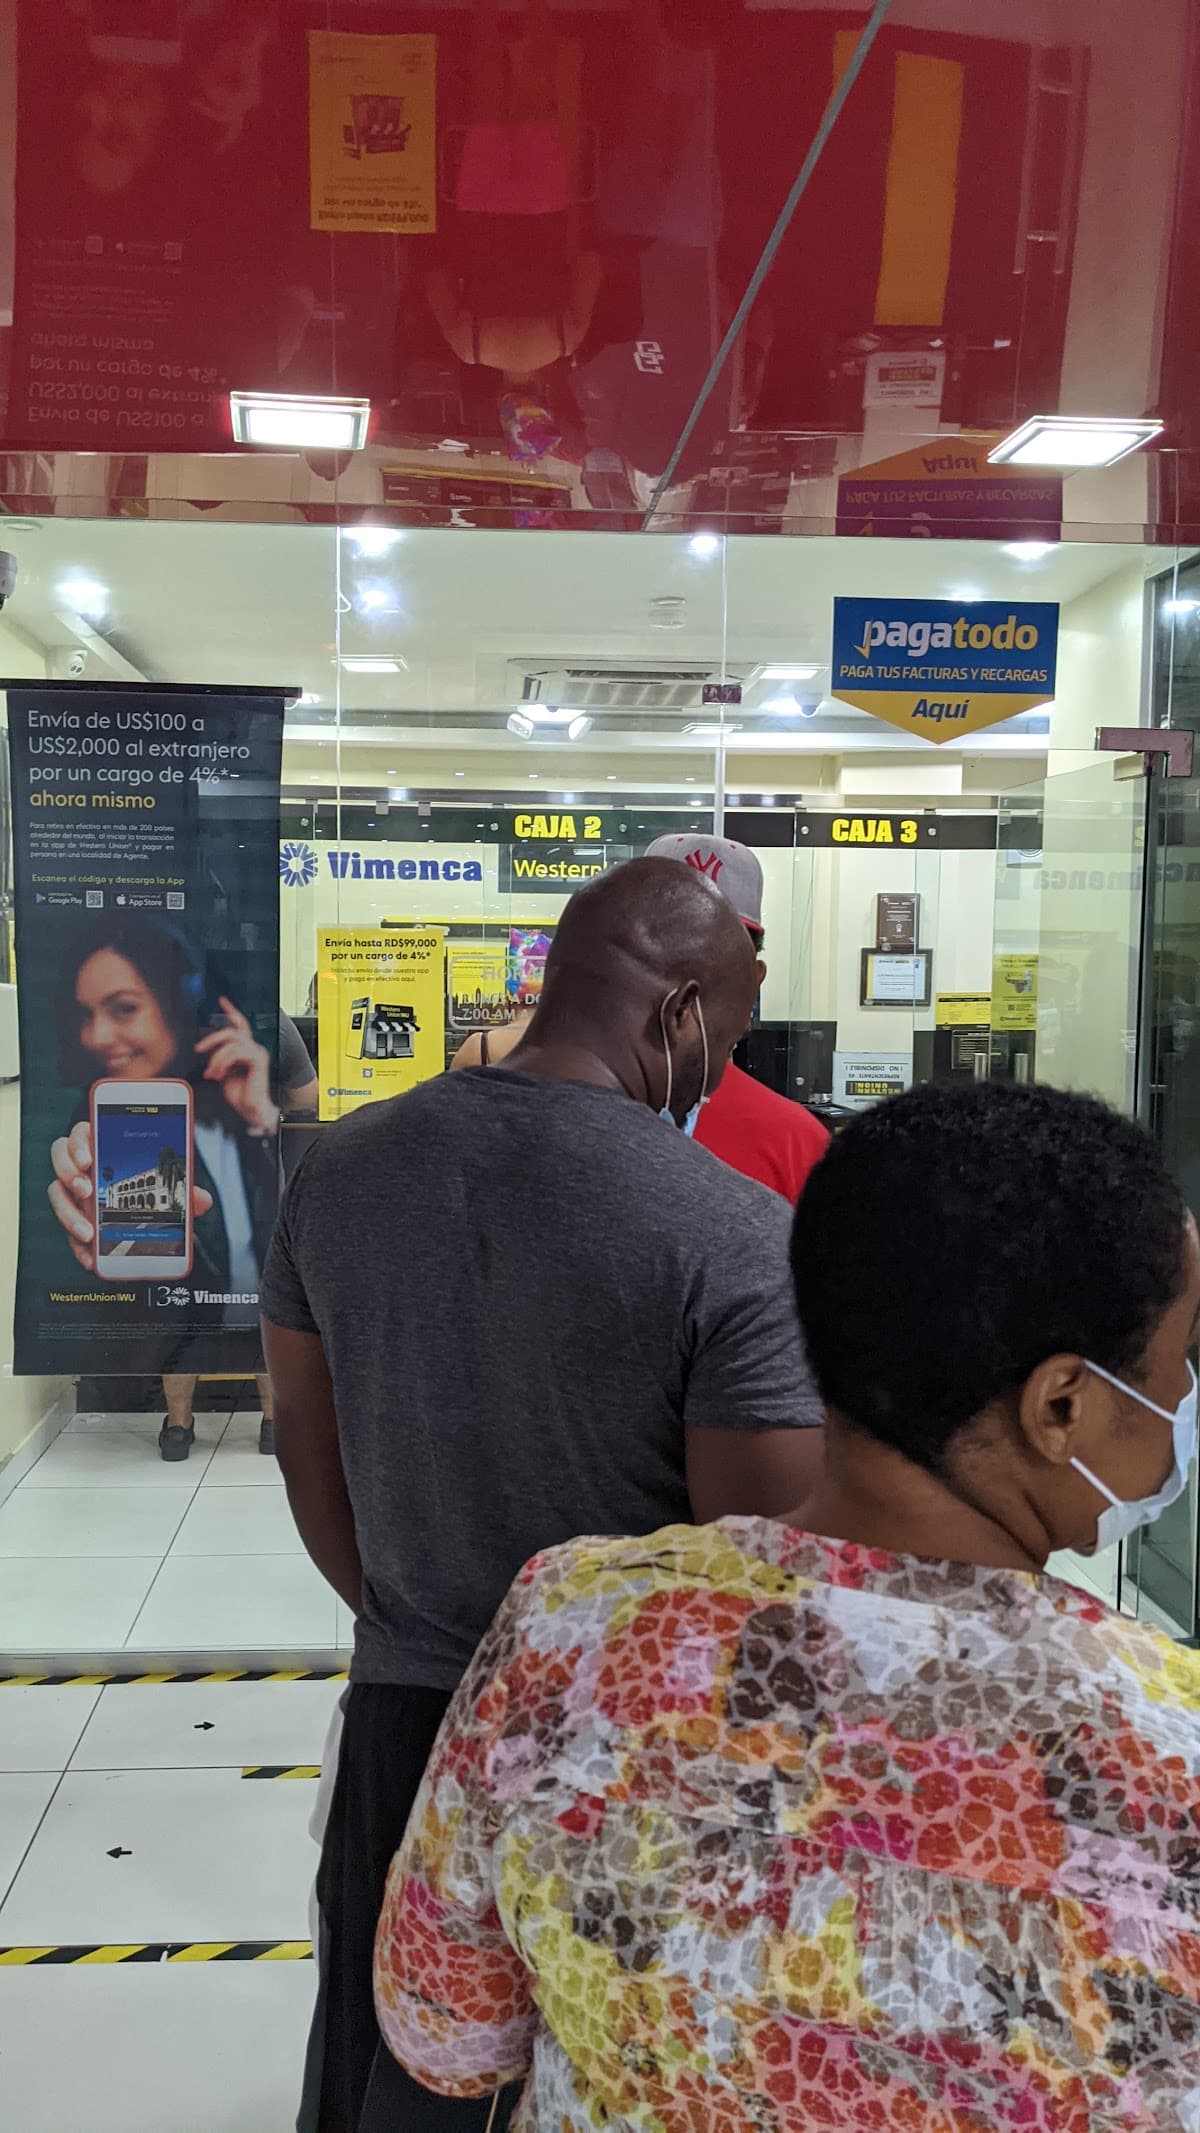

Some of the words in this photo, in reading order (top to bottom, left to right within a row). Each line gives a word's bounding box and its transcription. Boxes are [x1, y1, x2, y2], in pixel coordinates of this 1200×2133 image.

[854, 615, 1039, 659] pagatodo
[840, 665, 874, 678] PAGA
[876, 666, 901, 679] TUS
[902, 666, 968, 680] FACTURAS
[971, 668, 982, 680] Y
[981, 668, 1048, 682] RECARGAS
[911, 699, 970, 723] Aquí
[28, 710, 80, 729] Envía
[86, 712, 111, 729] de
[116, 712, 187, 732] US$100
[191, 718, 205, 731] a
[28, 736, 120, 757] US$2,000
[125, 739, 143, 756] al
[148, 741, 250, 762] extranjero
[29, 767, 62, 784] por
[68, 768, 92, 781] un
[97, 768, 154, 786] cargo
[159, 766, 184, 783] de
[29, 790, 87, 807] ahora
[92, 791, 156, 808] mismo
[514, 814, 577, 839] CAJA
[583, 816, 602, 839] 2
[831, 818, 894, 843] CAJA
[900, 820, 918, 843] 3
[327, 851, 483, 882] Vimenca
[32, 874, 67, 882] Escanea
[167, 877, 185, 886] App
[48, 897, 70, 905] Google
[129, 899, 143, 907] App
[144, 898, 162, 906] Store
[325, 938, 352, 947] Envía
[354, 939, 382, 947] hasta
[384, 938, 437, 948] RD$99,000
[331, 952, 348, 961] por
[365, 953, 393, 961] cargo
[396, 951, 408, 960] de
[193, 1290, 260, 1304] Vimenca
